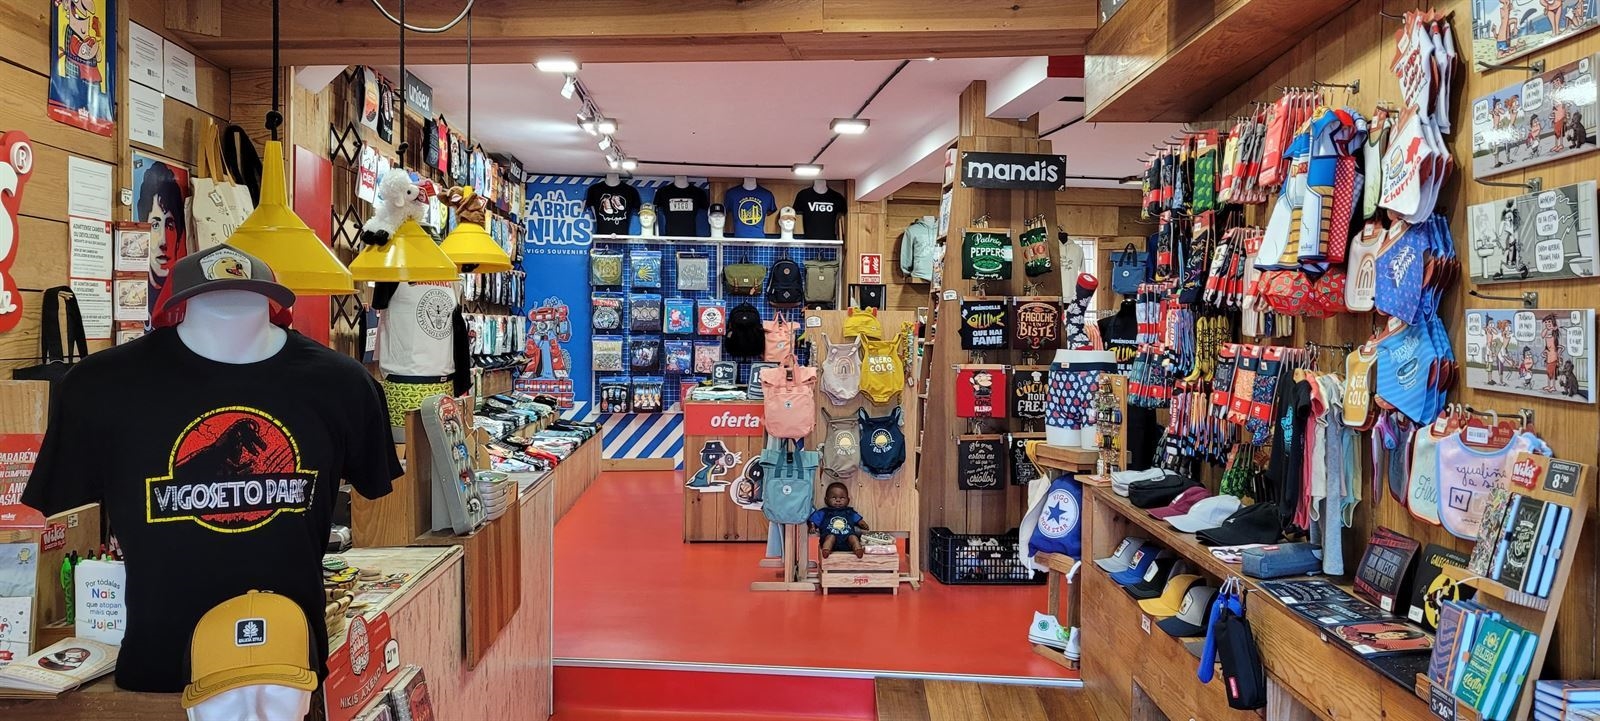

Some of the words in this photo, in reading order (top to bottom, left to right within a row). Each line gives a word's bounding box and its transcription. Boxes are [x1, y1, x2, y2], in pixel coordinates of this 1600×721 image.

[408, 82, 430, 113] unisex
[967, 161, 1059, 183] mandis
[550, 190, 566, 202] LA
[527, 193, 596, 219] ÁBRICA
[808, 202, 834, 213] VIGO
[527, 219, 591, 244] NIKIS
[970, 247, 1005, 258] PEPPERS
[1020, 311, 1054, 323] FAGOCHE
[972, 336, 1003, 346] FAME
[869, 356, 892, 364] QUERO
[869, 363, 893, 372] COLO
[1027, 393, 1045, 401] non
[711, 411, 760, 428] oferta
[154, 481, 263, 512] VIGOSETO
[266, 478, 308, 504] PARK
[1052, 493, 1070, 504] VIGO
[85, 580, 96, 589] Por
[91, 588, 116, 600] Nais
[86, 601, 98, 609] que
[99, 601, 122, 610] atopan
[340, 694, 359, 709] NIKIS
[360, 661, 385, 700] AXENDA
